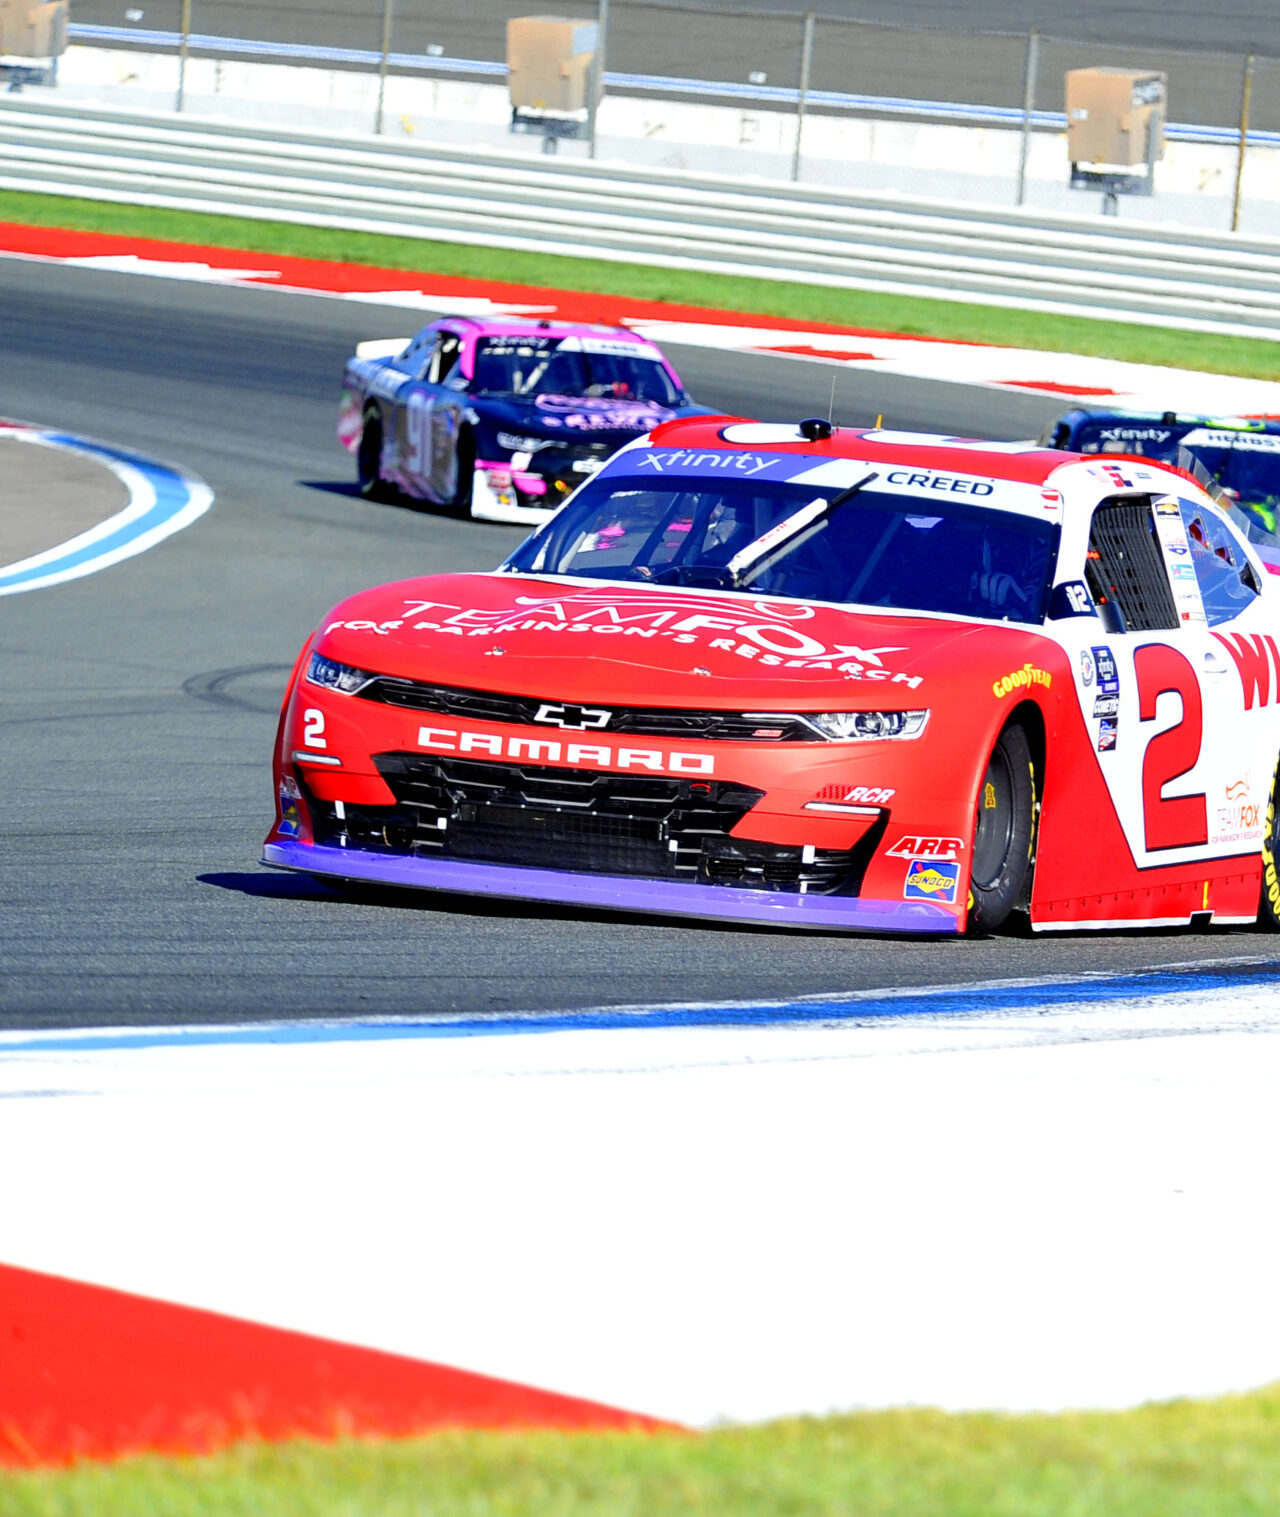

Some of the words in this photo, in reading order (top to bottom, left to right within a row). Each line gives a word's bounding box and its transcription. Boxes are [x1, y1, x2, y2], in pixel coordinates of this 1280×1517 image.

[1099, 427, 1171, 443] xfinity
[637, 450, 781, 476] xfinity
[886, 471, 994, 497] CREED
[323, 620, 404, 635] FOR
[413, 618, 700, 644] PARKINSON'S
[708, 638, 924, 689] RESEARCH
[992, 663, 1052, 698] GOODYEAR
[303, 708, 327, 749] 2
[417, 726, 715, 775] CAMARO
[1133, 643, 1209, 852] 2
[843, 786, 896, 803] RCR
[908, 874, 953, 889] SUNOCO
